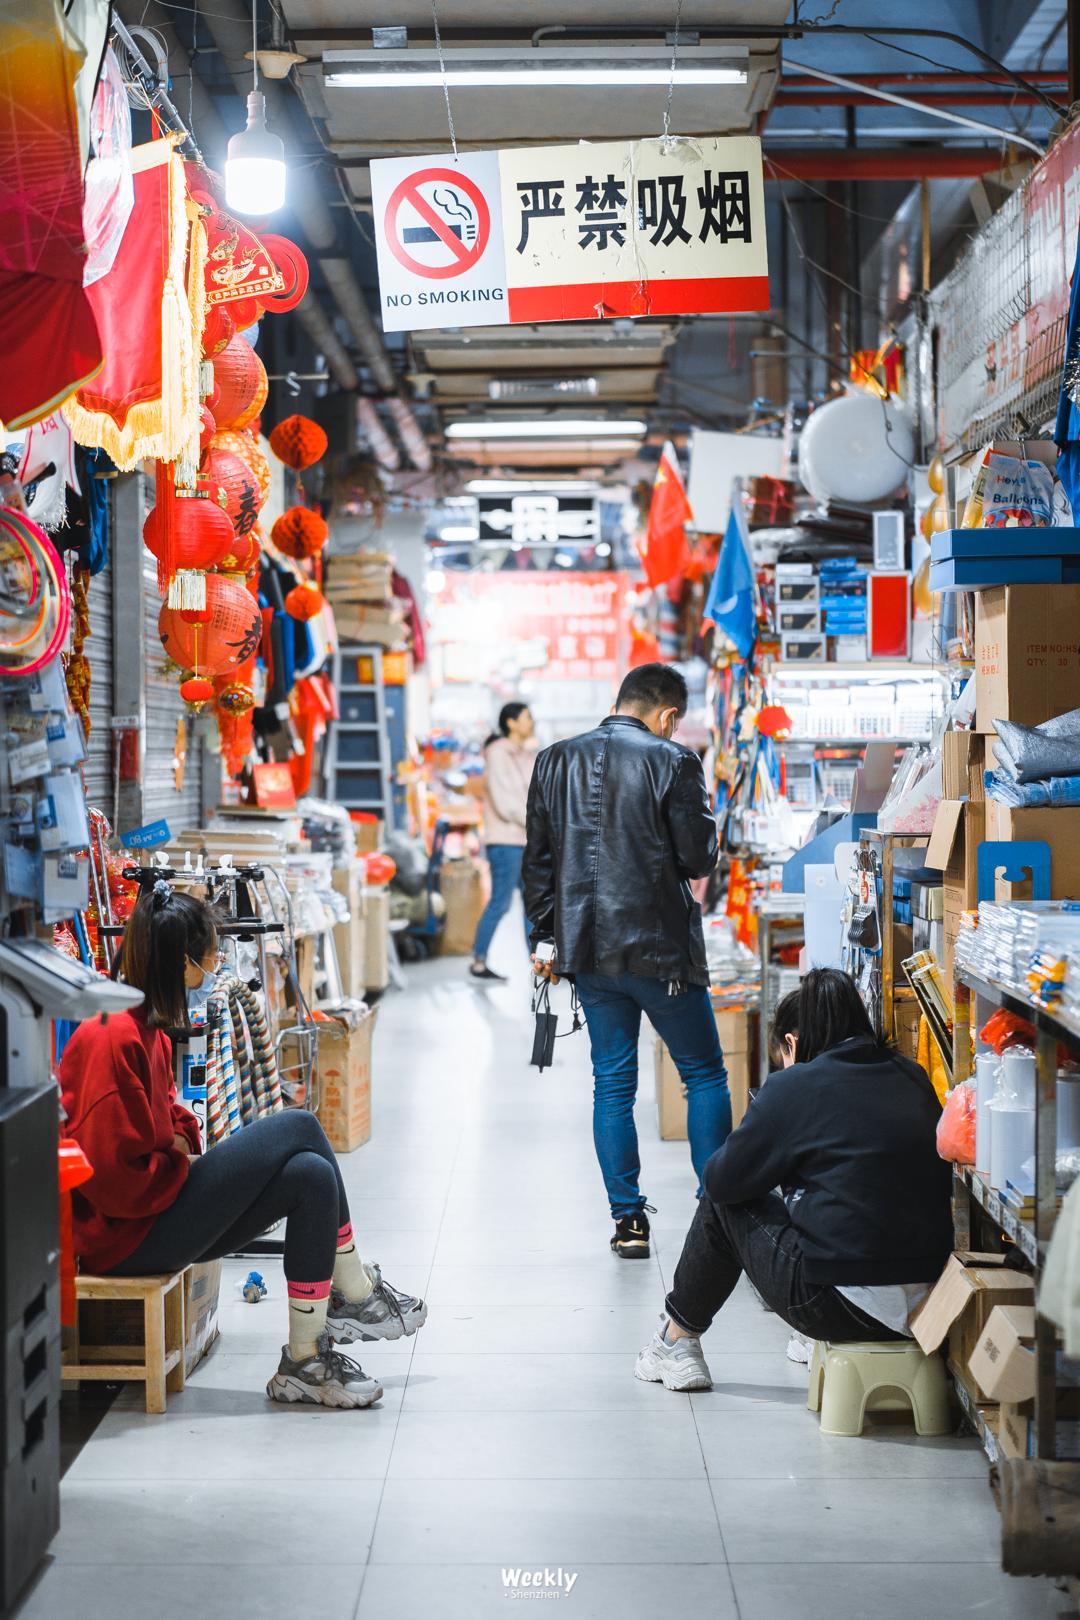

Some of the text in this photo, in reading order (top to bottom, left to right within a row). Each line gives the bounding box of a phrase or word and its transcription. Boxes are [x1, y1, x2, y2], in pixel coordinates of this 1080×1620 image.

[515, 169, 754, 255] 严禁吸烟
[386, 287, 504, 308] NO SMOKING
[993, 493, 1044, 505] Balloons
[1026, 644, 1047, 653] ITEM
